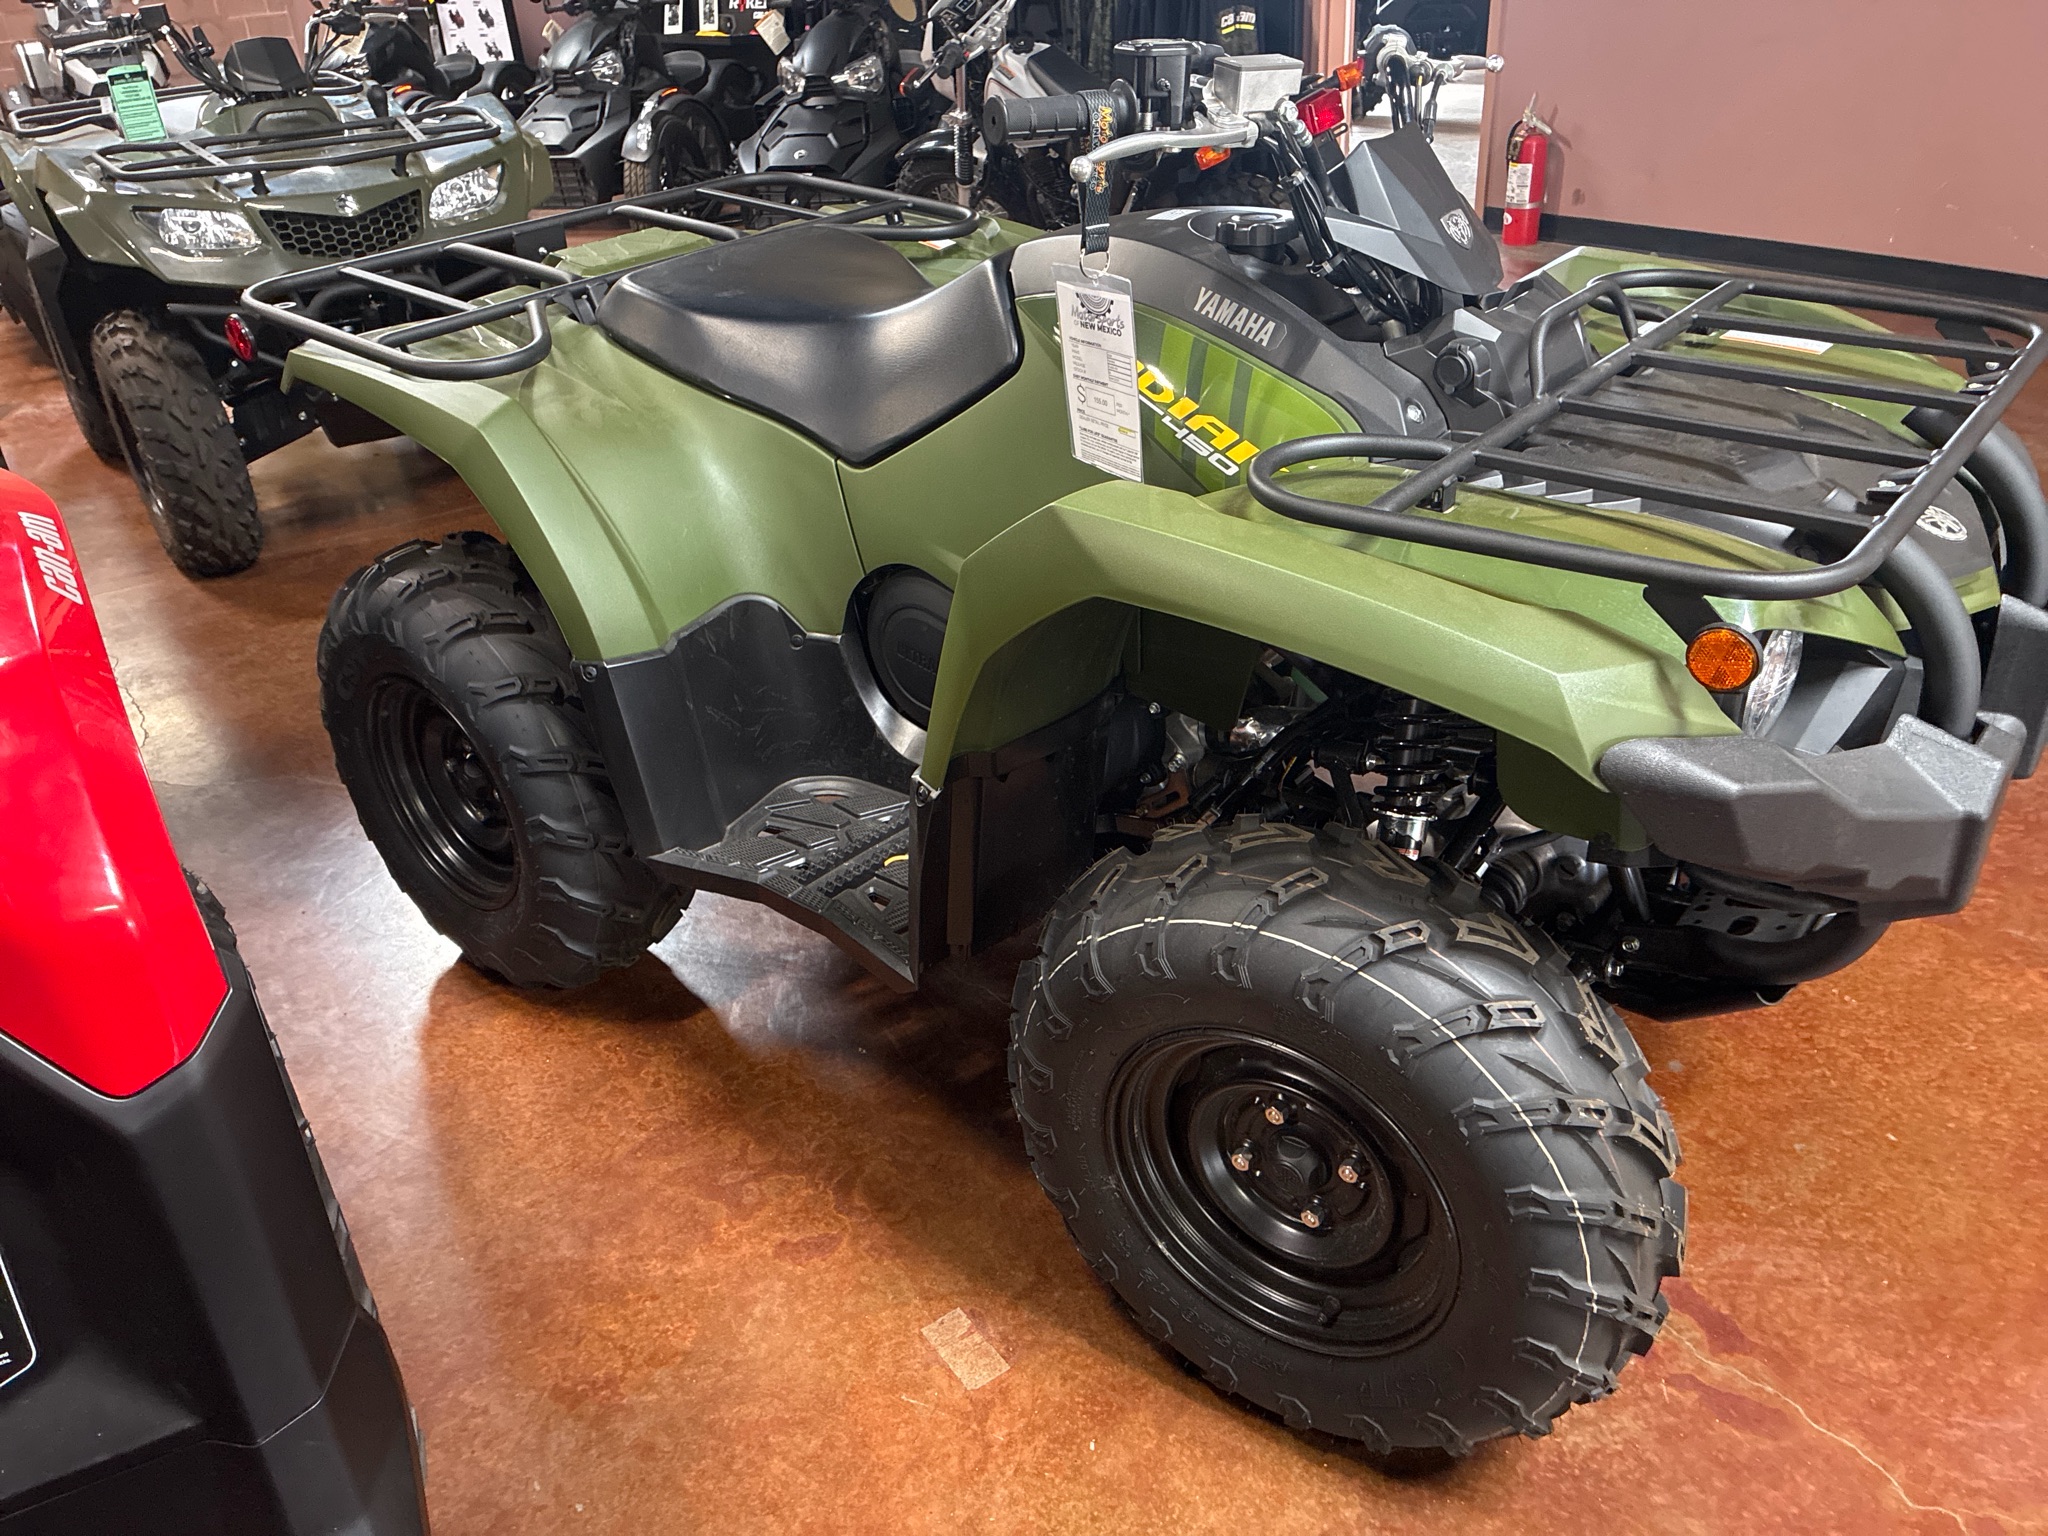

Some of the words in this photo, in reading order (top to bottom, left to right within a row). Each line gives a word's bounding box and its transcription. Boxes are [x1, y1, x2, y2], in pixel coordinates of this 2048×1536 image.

[1080, 320, 1096, 332] NEW
[1097, 324, 1123, 337] MEXICO
[1194, 287, 1276, 347] YAMAHA
[1161, 415, 1240, 476] 450
[18, 511, 84, 606] can-am
